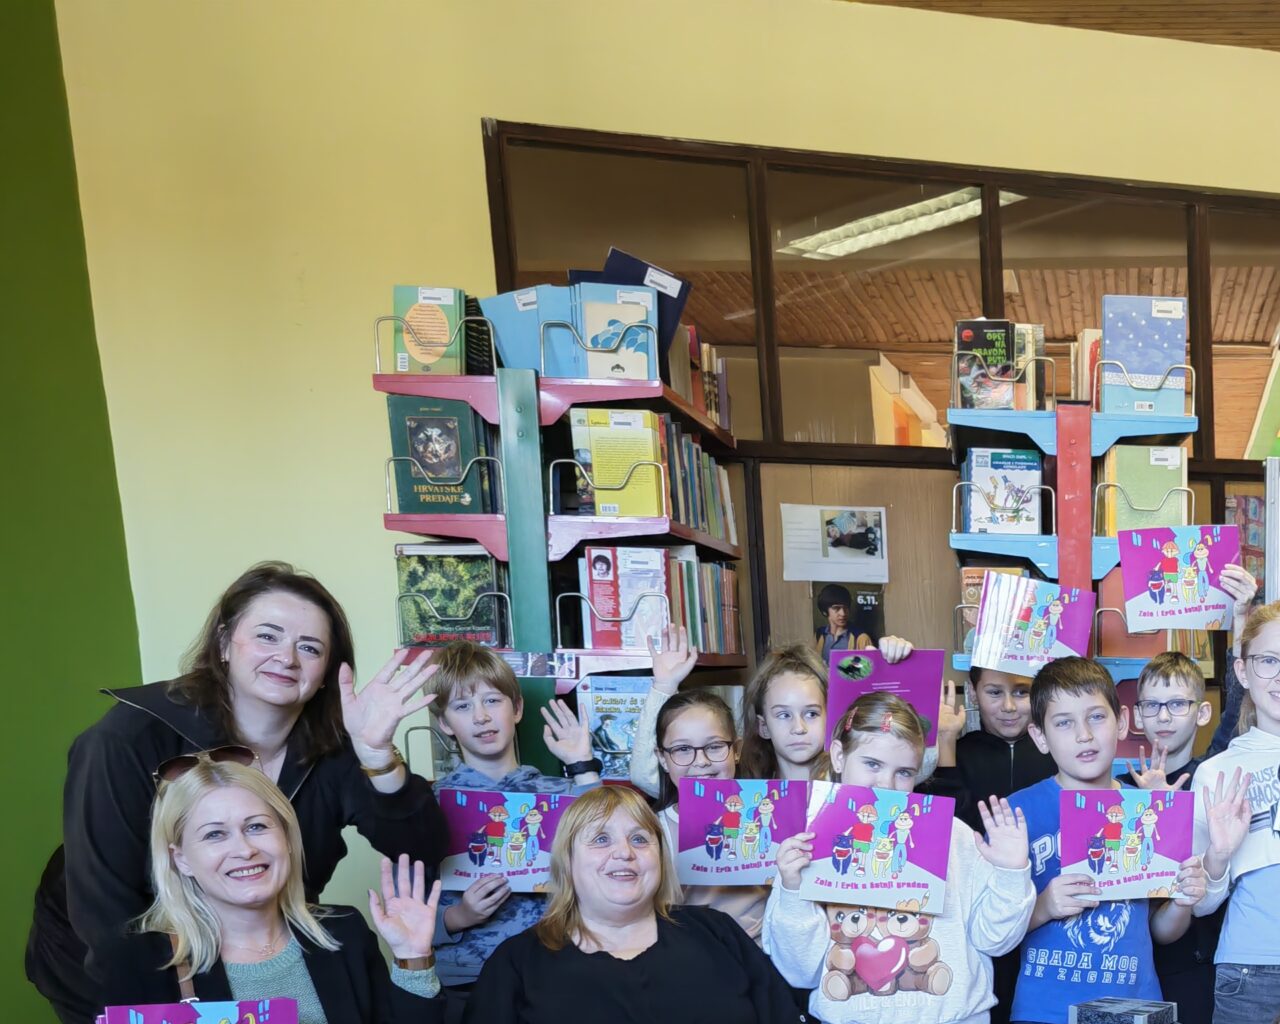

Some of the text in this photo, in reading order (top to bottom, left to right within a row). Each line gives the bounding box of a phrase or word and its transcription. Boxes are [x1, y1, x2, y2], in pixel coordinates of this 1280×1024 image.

[413, 484, 463, 493] HRVATSKE
[420, 494, 460, 503] PREDAJE
[857, 595, 878, 605] 6.11.
[1251, 766, 1276, 784] AUSE
[1246, 779, 1280, 811] HAOS
[1027, 947, 1139, 972] GRADA MOG
